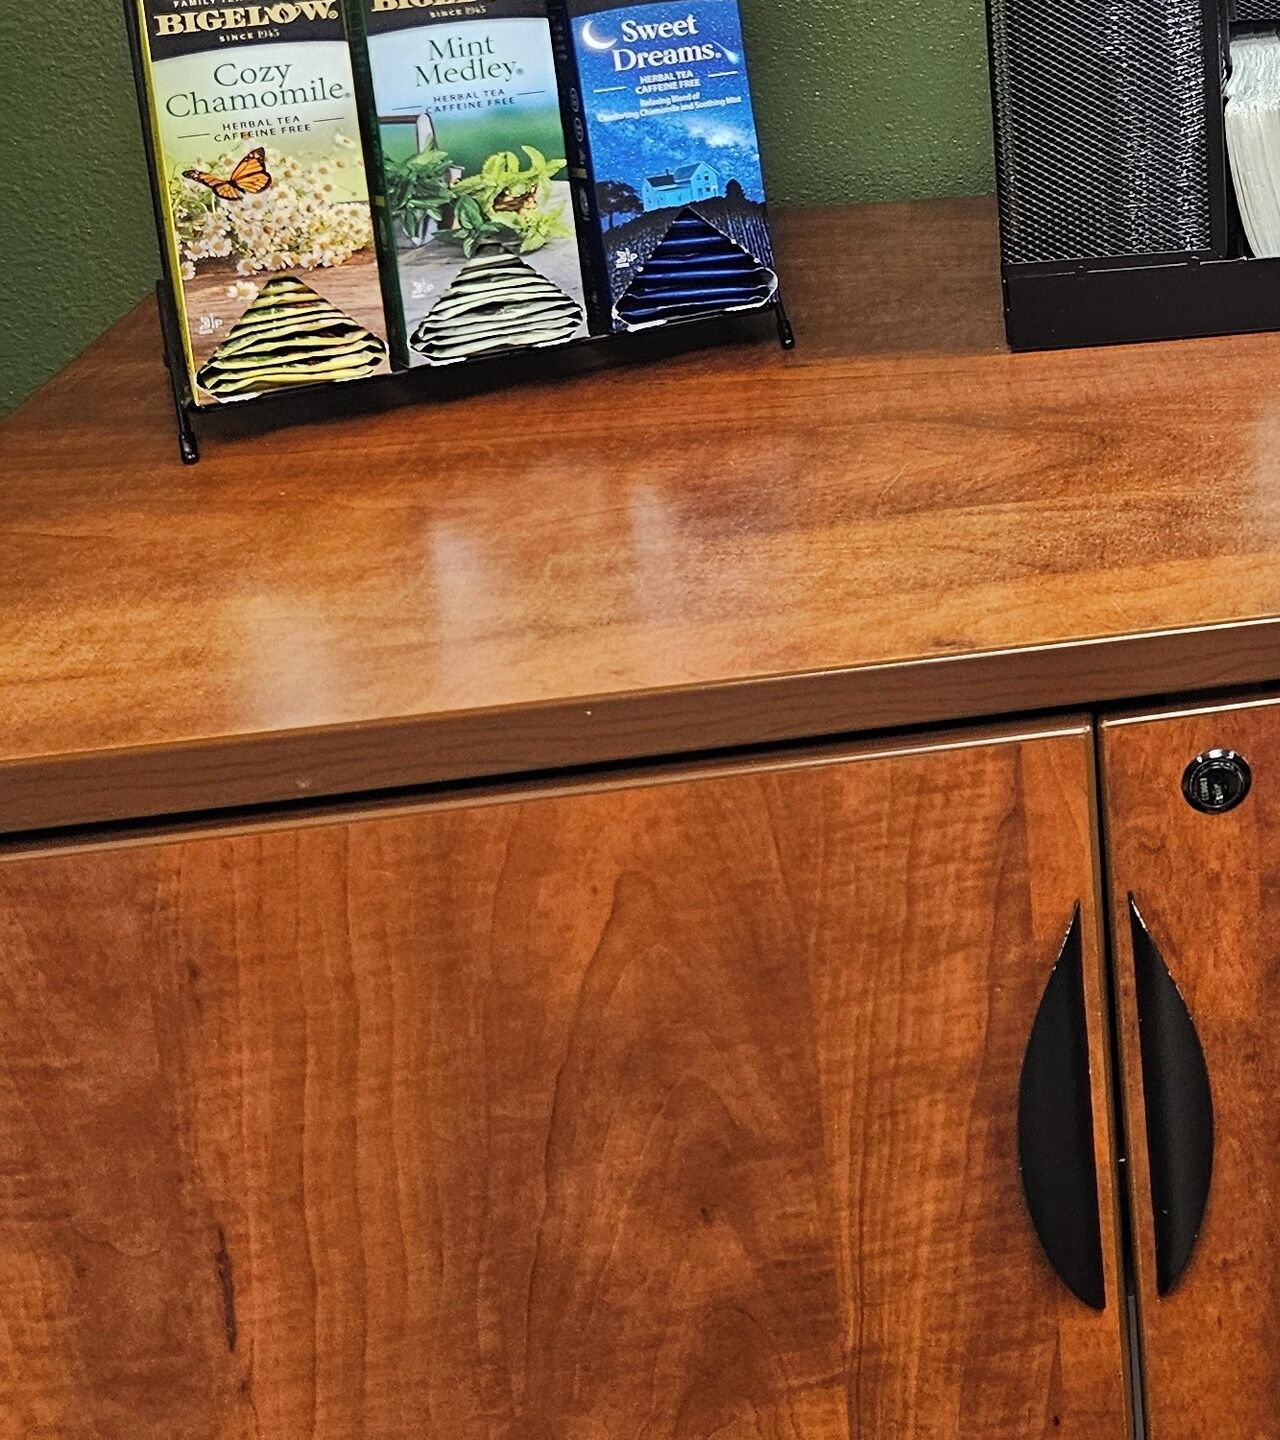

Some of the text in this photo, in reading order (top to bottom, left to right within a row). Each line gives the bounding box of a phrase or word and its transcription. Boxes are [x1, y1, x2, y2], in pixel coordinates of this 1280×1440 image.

[218, 32, 254, 43] SINCE
[621, 13, 699, 43] Sweet
[428, 35, 496, 61] Mint
[612, 43, 715, 72] Dreams
[212, 62, 293, 97] Cozy
[415, 58, 517, 88] Medley
[640, 70, 694, 84] HERBAL TEA
[165, 77, 347, 119] Chamomile
[433, 88, 505, 104] HERBAL TEA
[635, 81, 679, 95] CAFFEINE
[425, 97, 515, 114] CAFFEINE FREE
[213, 123, 311, 143] CAFFEINE FREE
[222, 115, 300, 132] HERBAL TEA
